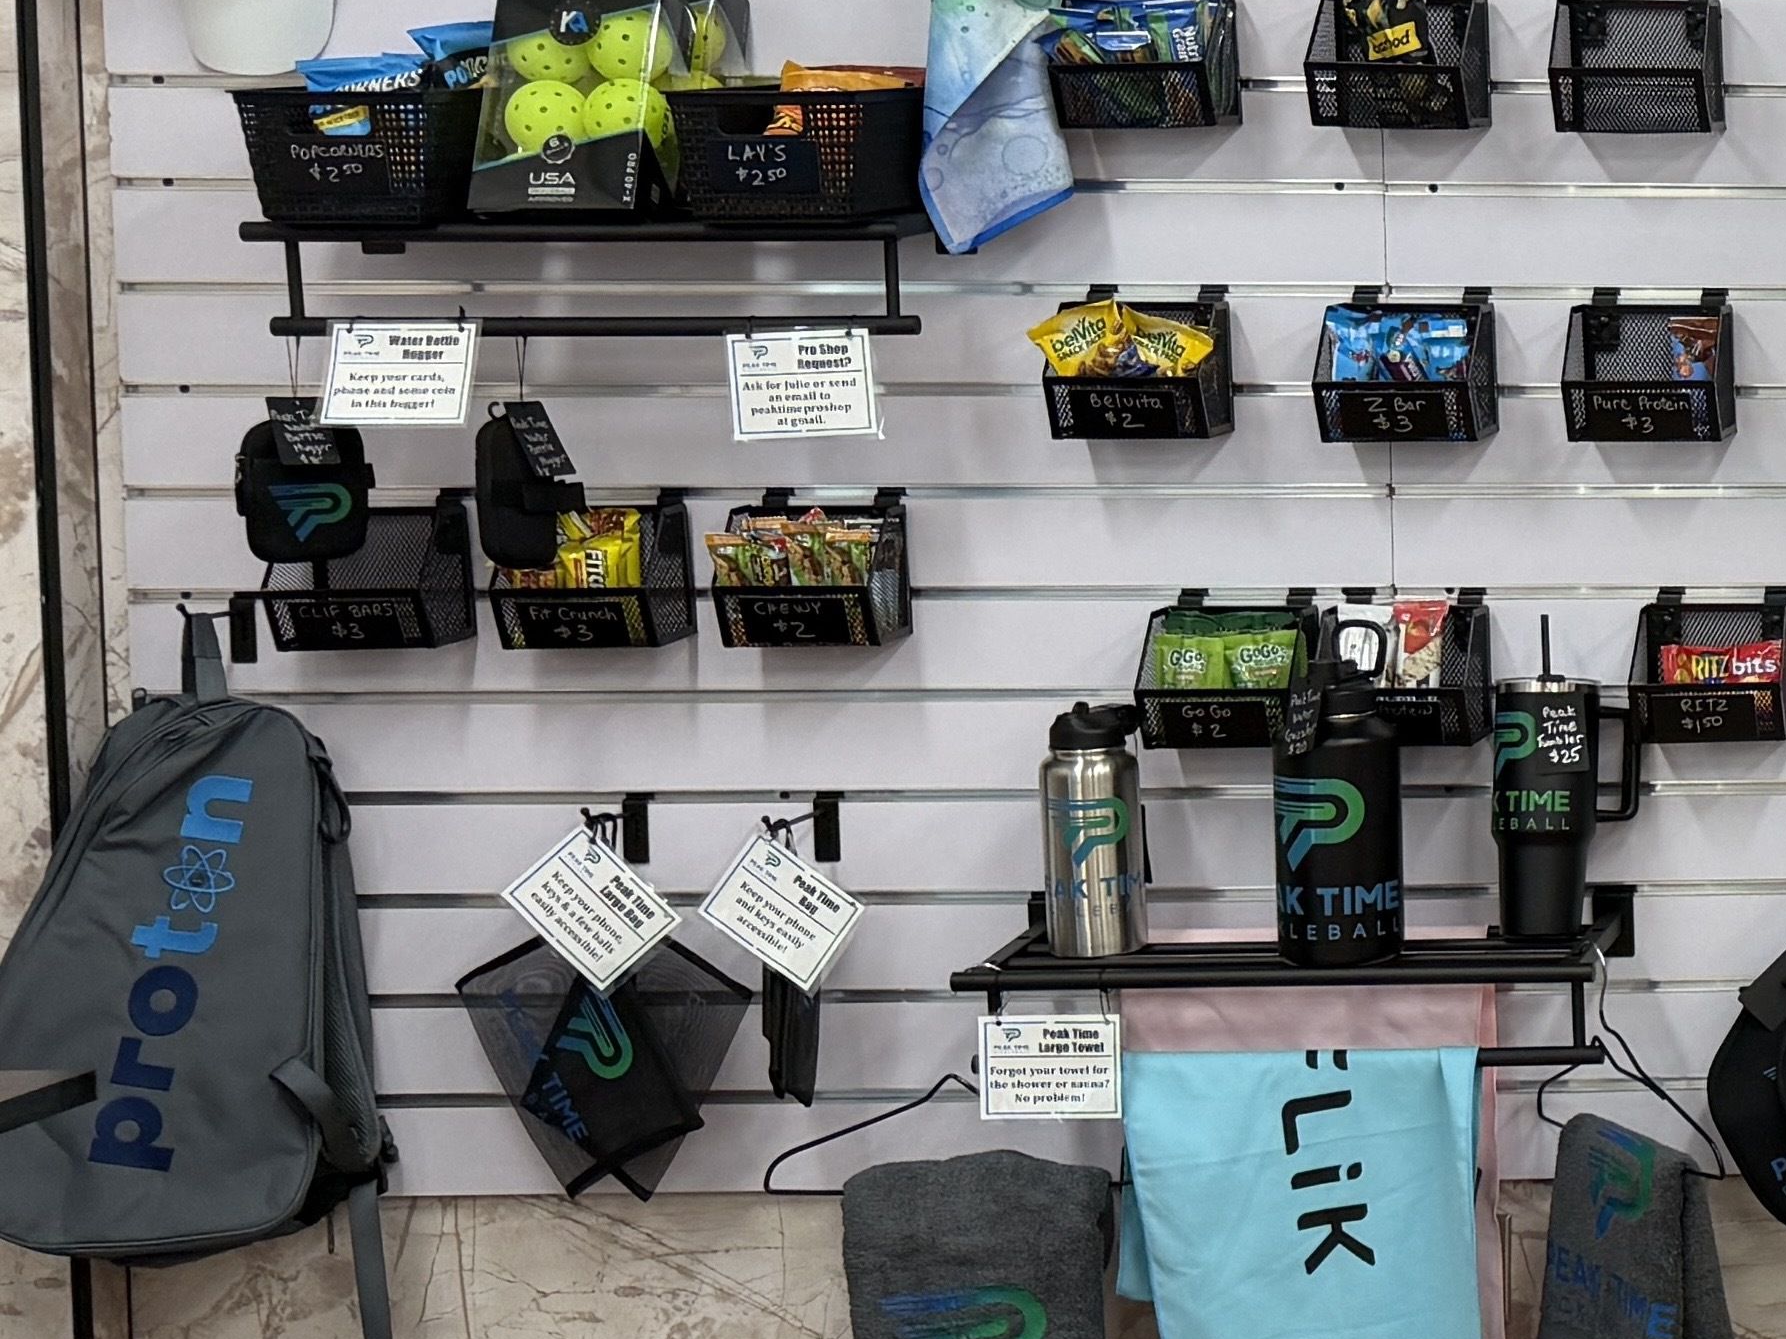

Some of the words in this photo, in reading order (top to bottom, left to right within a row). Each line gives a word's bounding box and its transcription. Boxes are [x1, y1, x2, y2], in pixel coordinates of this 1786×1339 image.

[290, 143, 385, 159] POPCORNERS
[727, 145, 787, 162] LAY'S
[529, 172, 575, 184] USA
[1050, 316, 1106, 353] belVita
[798, 345, 816, 355] Pro
[820, 344, 848, 355] Shop
[797, 358, 851, 370] Request?
[743, 381, 762, 391] Ask
[766, 381, 780, 389] for
[829, 378, 856, 387] send
[785, 392, 816, 401] email
[820, 392, 831, 400] to
[1364, 397, 1387, 412] Z
[1394, 397, 1426, 410] Bar
[1593, 395, 1631, 410] Pure
[1638, 396, 1689, 411] Protein
[1105, 411, 1145, 427] $2
[1373, 414, 1413, 432] $3
[1622, 414, 1654, 433] $3
[299, 605, 340, 619] CLIF
[348, 604, 394, 618] BARS
[558, 608, 619, 621] Crunch
[754, 602, 822, 615] CHEWY
[331, 623, 365, 639] $3
[553, 625, 593, 641] $3
[1691, 656, 1728, 679] RITZ
[1732, 655, 1777, 676] bits
[1182, 705, 1204, 718] Go
[1210, 705, 1231, 718] Go
[1542, 706, 1576, 718] Peak
[1681, 700, 1728, 713] RITZ
[1542, 721, 1578, 732] Time
[1549, 749, 1580, 763] $25
[1505, 791, 1571, 812] TIME
[610, 875, 635, 899] Peak
[632, 893, 655, 920] Time
[793, 875, 817, 897] Peak
[818, 890, 841, 913] Time
[1316, 880, 1400, 916] TIME
[552, 871, 574, 896] Keep
[573, 892, 595, 917] your
[593, 914, 623, 945] phone,
[599, 885, 627, 912] Large
[623, 907, 645, 929] Bag
[740, 881, 763, 904] Keep
[764, 900, 787, 920] your
[785, 915, 816, 941] phone
[798, 895, 819, 916] Bag
[541, 881, 561, 904] keys
[575, 913, 593, 934] few
[592, 931, 616, 955] balls
[735, 896, 754, 913] and
[754, 910, 776, 929] keys
[776, 925, 805, 949] easily
[531, 892, 556, 919] easily
[554, 917, 604, 963] accessible!
[736, 915, 788, 953] accessible!
[1043, 1028, 1070, 1039] Peak
[1072, 1028, 1099, 1039] Time
[1038, 1043, 1069, 1054] Large
[1072, 1042, 1104, 1053] Towel
[990, 1066, 1026, 1078] Forgot
[1030, 1067, 1056, 1077] your
[1060, 1066, 1089, 1074] towel
[1092, 1066, 1109, 1074] for
[990, 1080, 1008, 1089] the
[1011, 1080, 1051, 1088] shower
[1015, 1094, 1030, 1102] No
[1033, 1093, 1085, 1104] problem!
